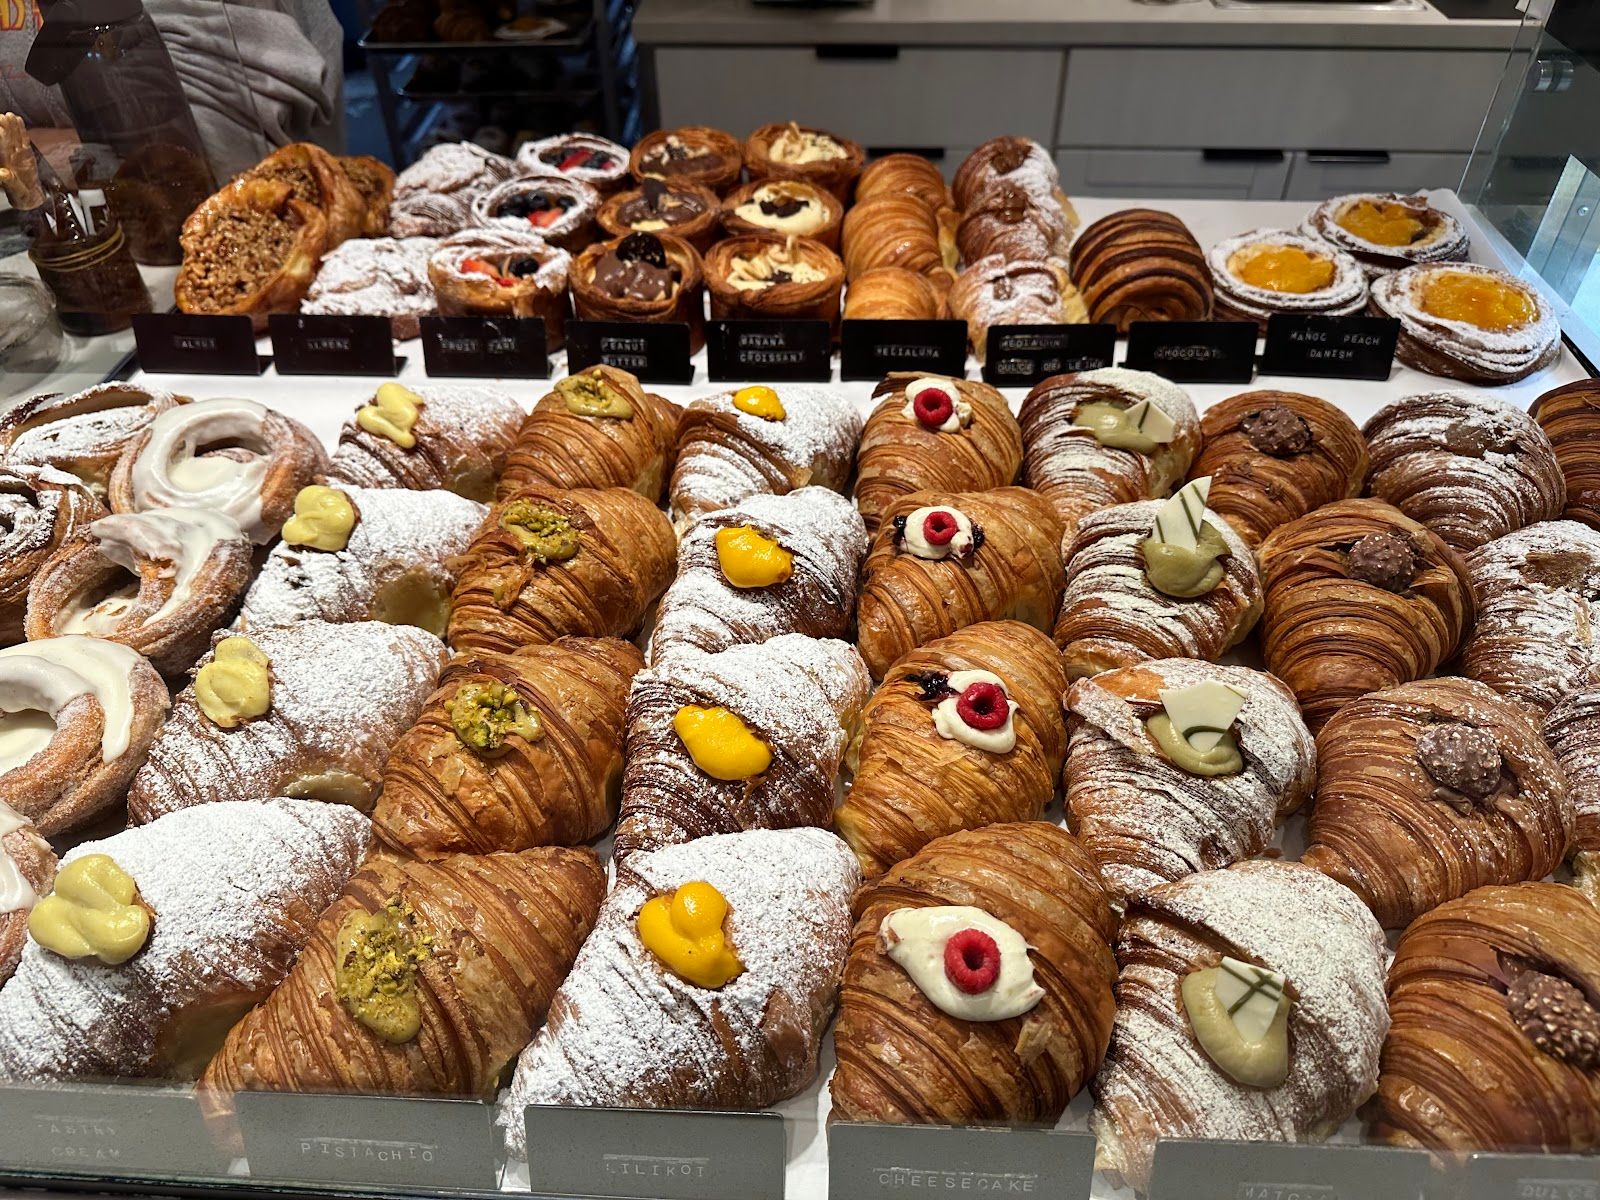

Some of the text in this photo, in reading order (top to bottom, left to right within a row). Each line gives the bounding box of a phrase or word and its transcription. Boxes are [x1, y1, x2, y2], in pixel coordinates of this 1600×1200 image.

[601, 340, 645, 351] PEANUT
[741, 337, 785, 346] BANANA
[739, 352, 803, 363] CROISSANT
[51, 1146, 121, 1159] CREAM
[300, 1142, 434, 1162] PISTACHIO
[878, 1173, 1035, 1192] CHEESECAKE
